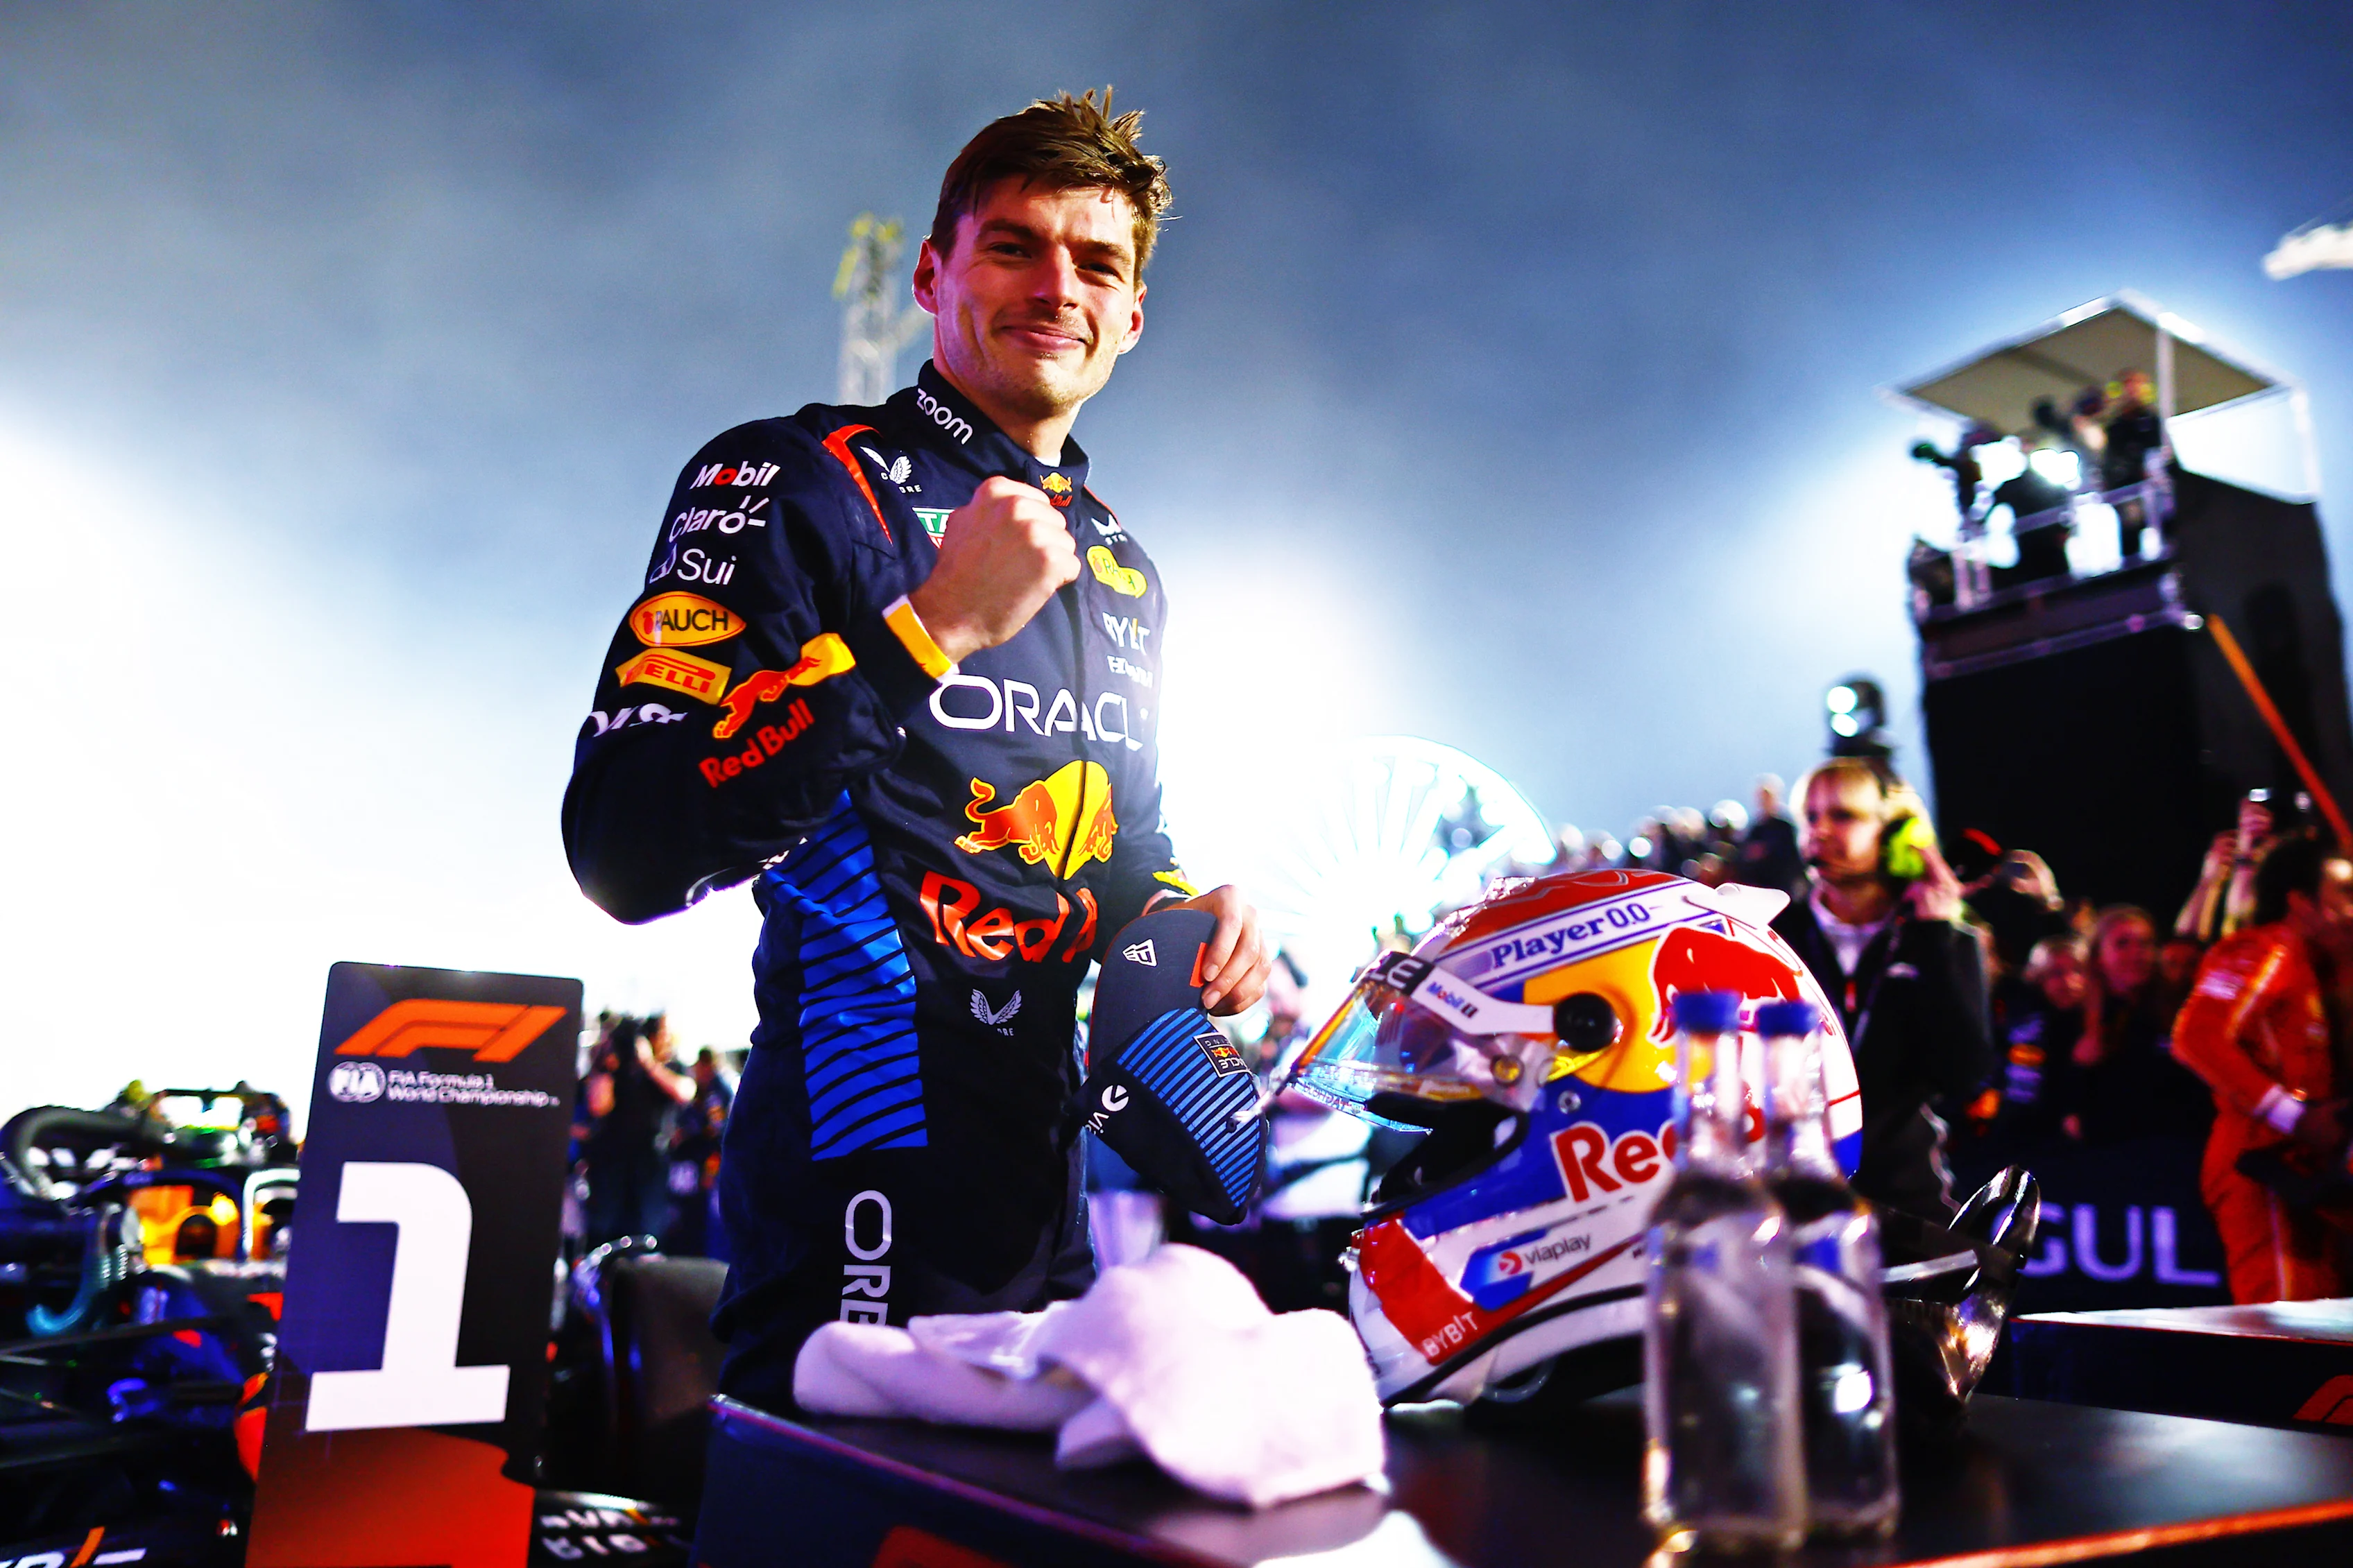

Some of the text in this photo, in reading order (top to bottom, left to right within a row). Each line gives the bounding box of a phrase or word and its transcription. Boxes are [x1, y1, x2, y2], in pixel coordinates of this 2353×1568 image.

[917, 388, 973, 445] zoom
[689, 460, 781, 490] Mobil
[676, 548, 737, 585] Sui
[654, 608, 729, 632] RAUCH
[928, 673, 1149, 751] ORACL
[699, 697, 815, 789] Red Bull
[919, 870, 1071, 963] Red
[1491, 903, 1651, 969] Player 0.0
[334, 999, 567, 1062] F1
[331, 1067, 384, 1099] FIA
[386, 1085, 549, 1108] World Championship
[418, 1071, 485, 1090] Formula
[1554, 1125, 1676, 1203] Re
[1523, 1234, 1591, 1265] viaplay
[305, 1160, 511, 1432] 1
[1422, 1311, 1479, 1357] BYBIT
